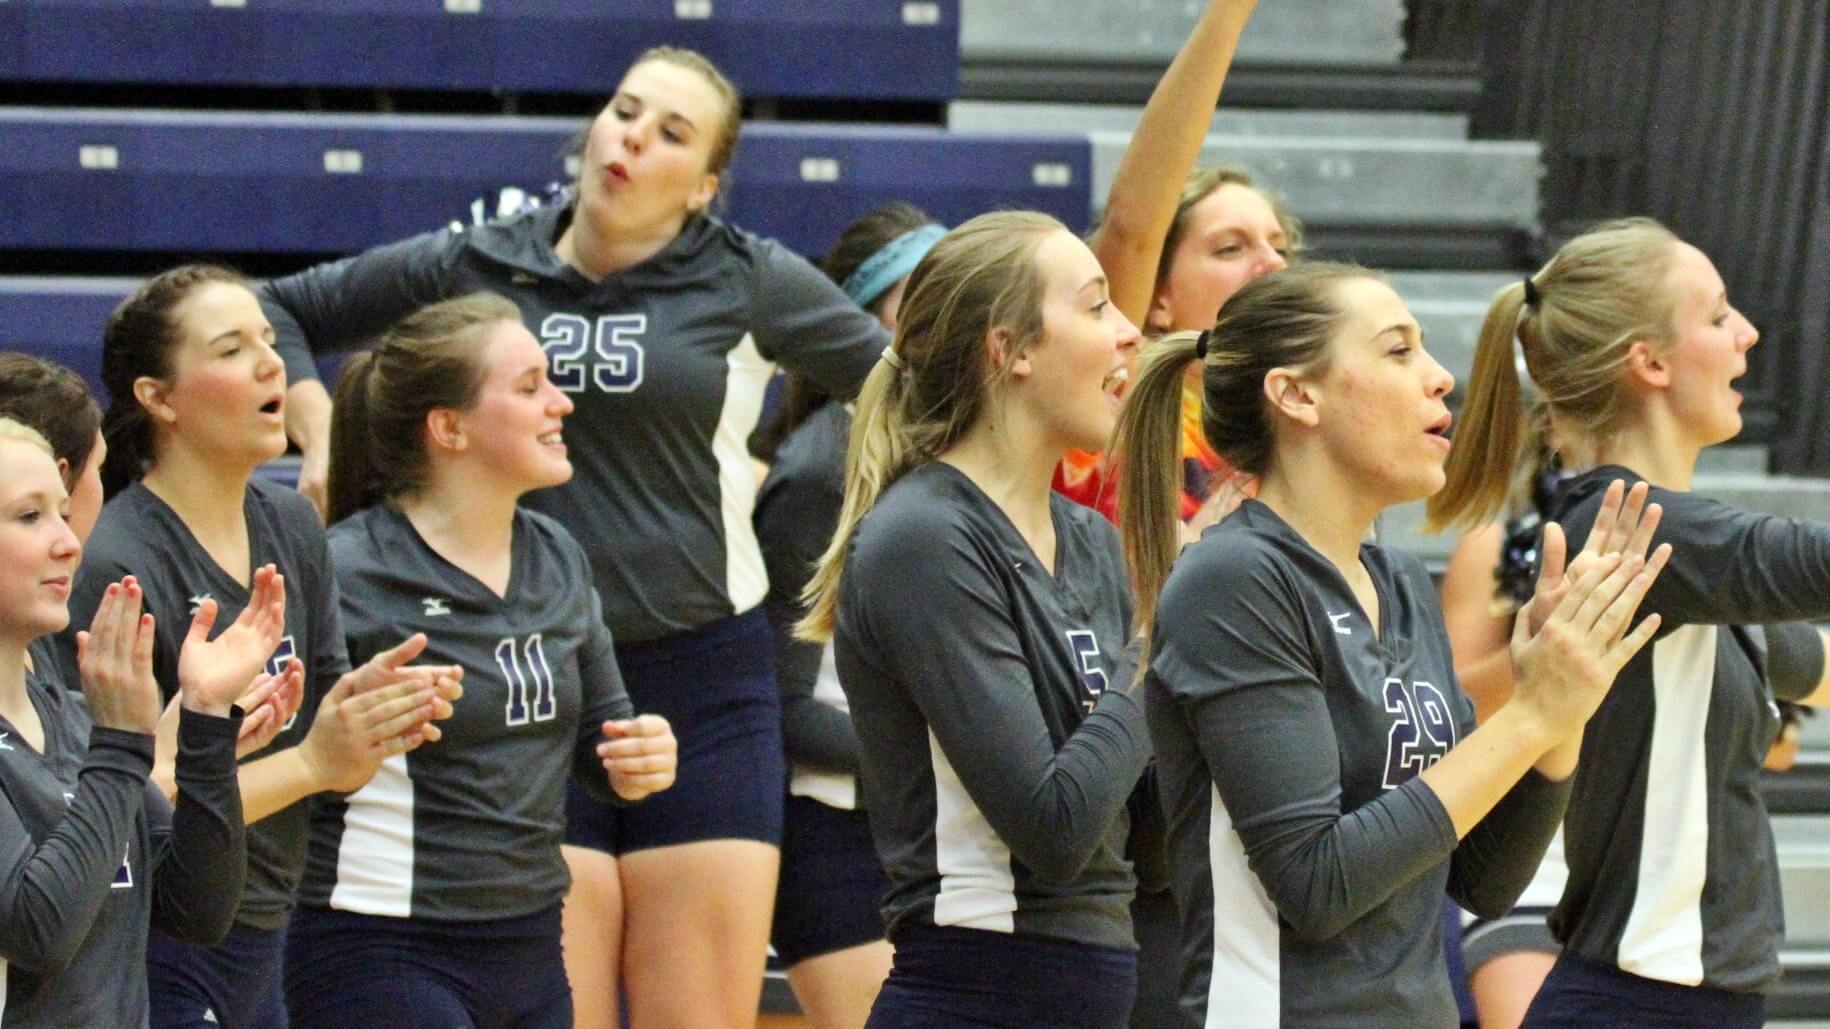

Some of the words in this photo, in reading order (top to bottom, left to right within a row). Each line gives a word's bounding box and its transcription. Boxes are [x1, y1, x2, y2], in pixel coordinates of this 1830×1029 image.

[541, 312, 647, 393] 25
[495, 633, 557, 727] 11
[1381, 678, 1456, 790] 29
